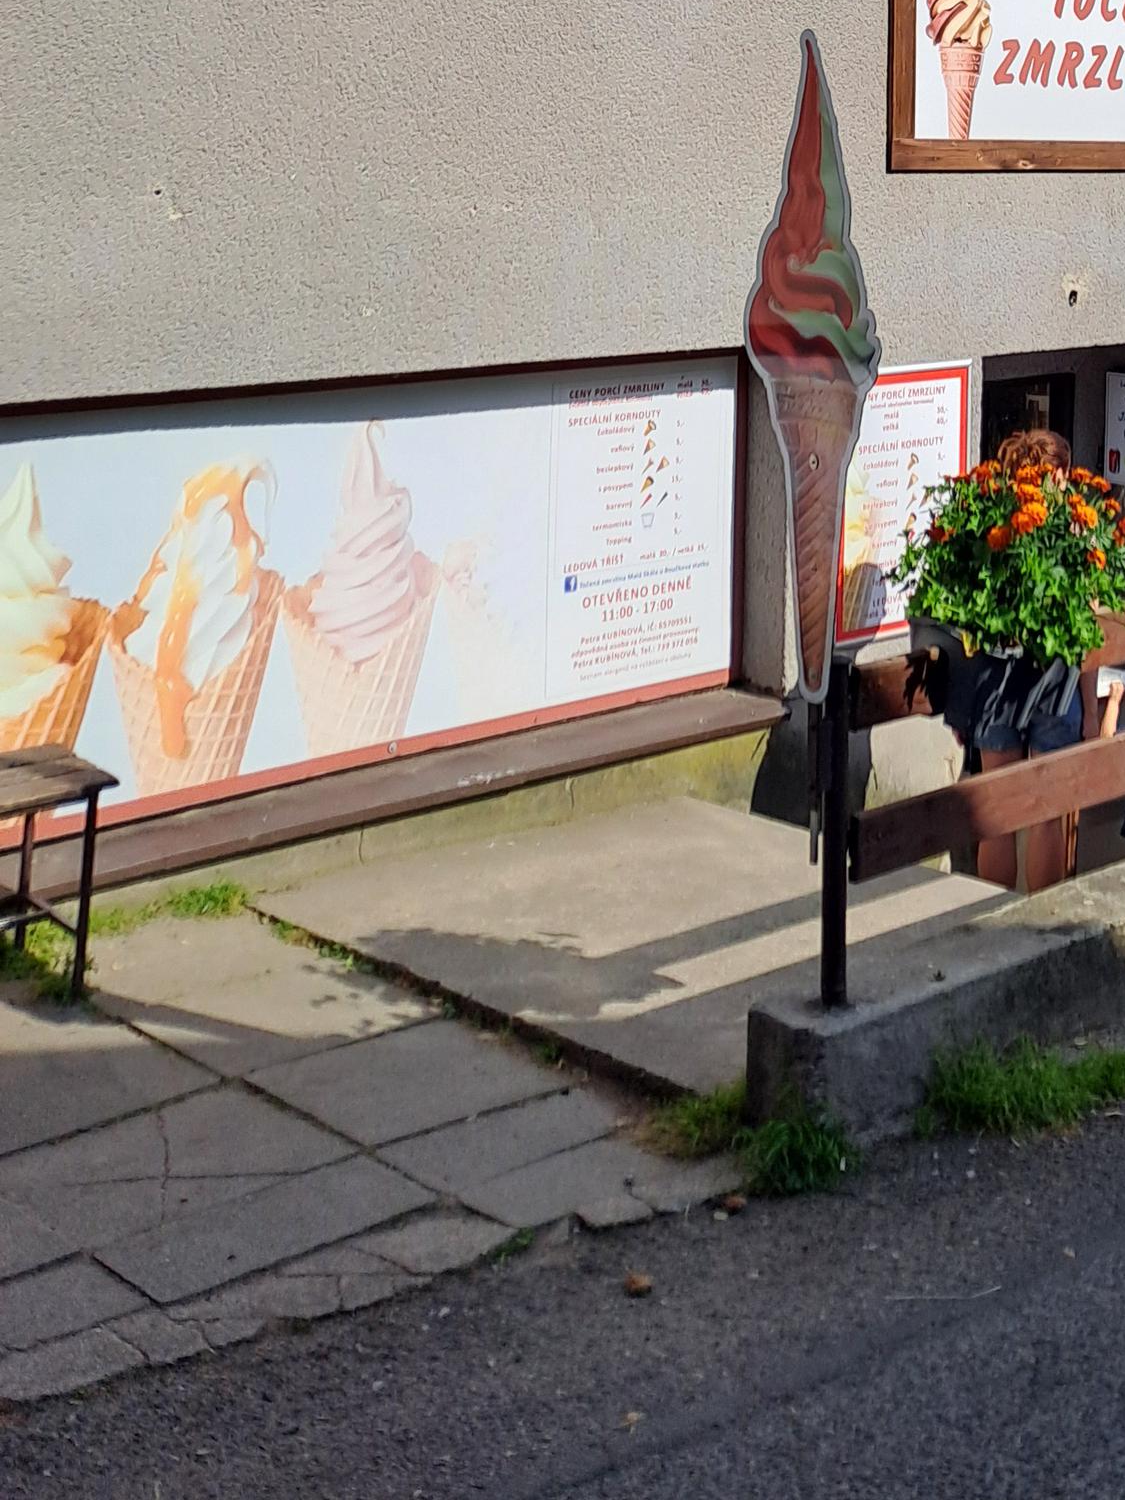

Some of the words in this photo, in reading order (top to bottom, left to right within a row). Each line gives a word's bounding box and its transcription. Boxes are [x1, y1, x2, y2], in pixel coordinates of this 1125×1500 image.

[569, 389, 592, 399] CENY
[594, 384, 621, 396] PORCÍ
[623, 382, 665, 394] ZMRZLINY
[881, 388, 906, 401] PORCÍ
[907, 385, 946, 398] ZMRZLINY
[568, 414, 612, 427] SPECIÁLNÍ
[615, 409, 661, 422] KORNOUTY
[884, 411, 899, 420] malá
[882, 424, 899, 432] velká
[858, 440, 899, 455] SPECIÁLNÍ
[901, 436, 944, 449] KORNOUTY
[563, 559, 598, 574] LEDOVÁ
[582, 585, 649, 609] OTEVŘENO
[652, 575, 692, 596] DENNĚ
[602, 605, 633, 622] 11:00
[643, 598, 674, 615] 17:00
